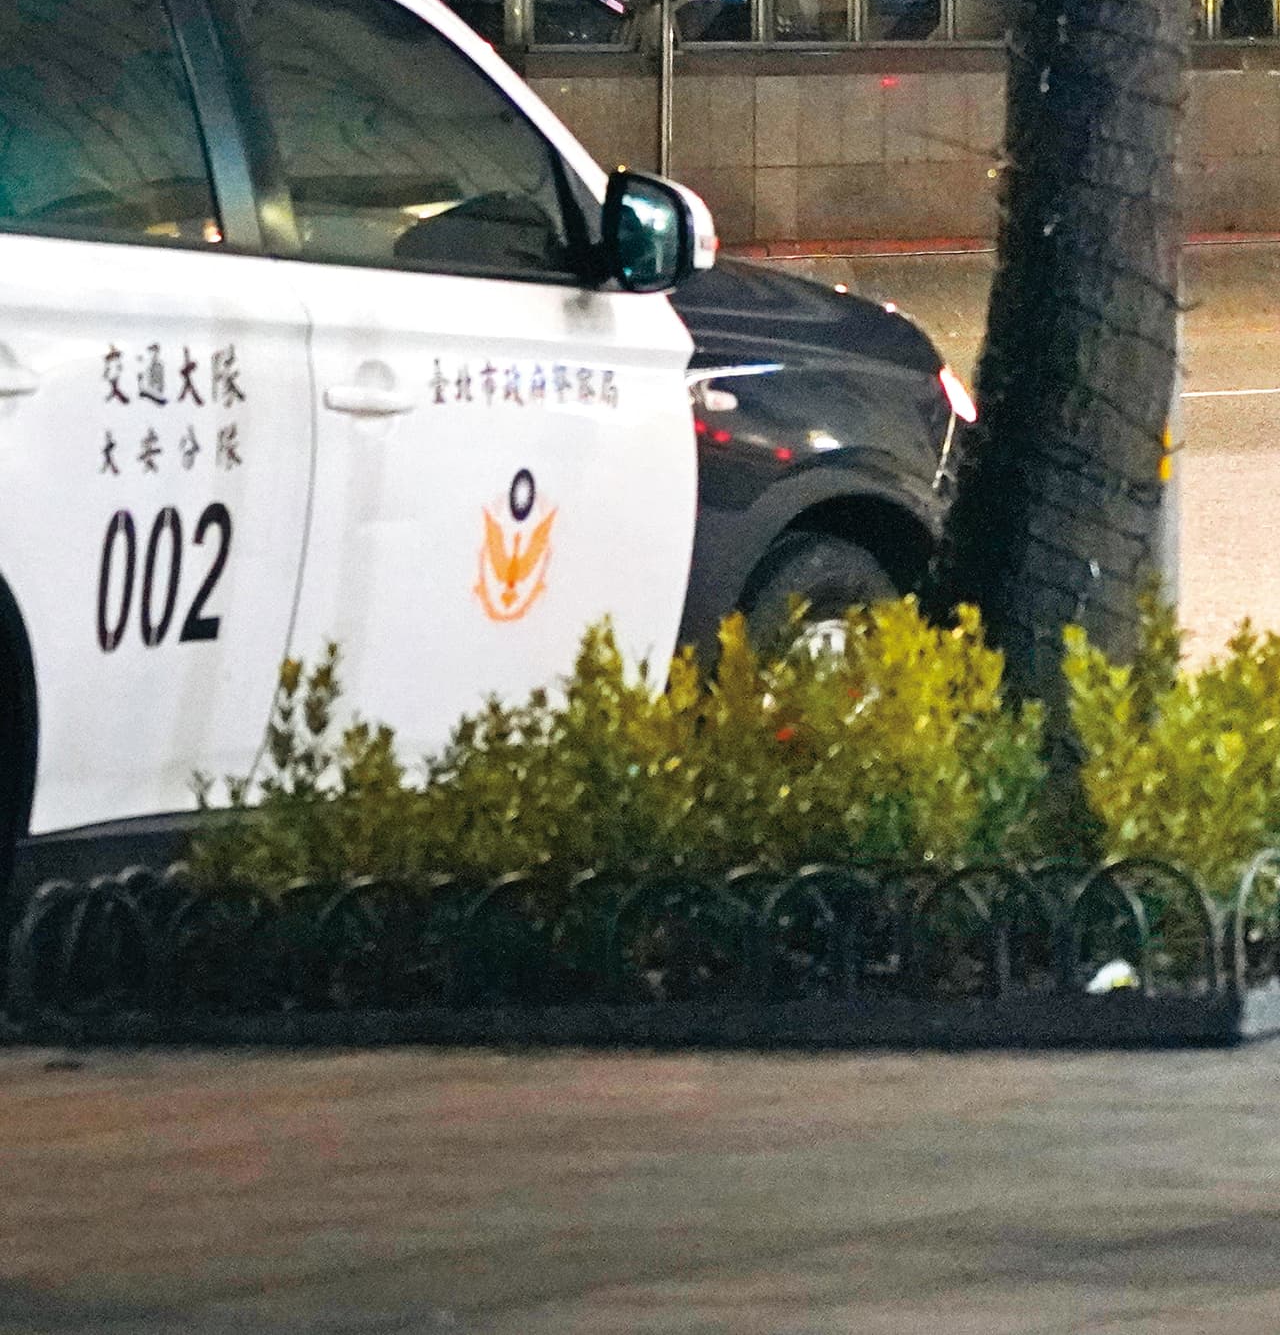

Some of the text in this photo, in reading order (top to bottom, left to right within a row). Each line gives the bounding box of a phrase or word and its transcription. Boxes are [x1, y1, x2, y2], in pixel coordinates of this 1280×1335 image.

[102, 343, 246, 409] 交通大隊
[99, 422, 244, 477] 大安分隊
[96, 500, 234, 654] 002
